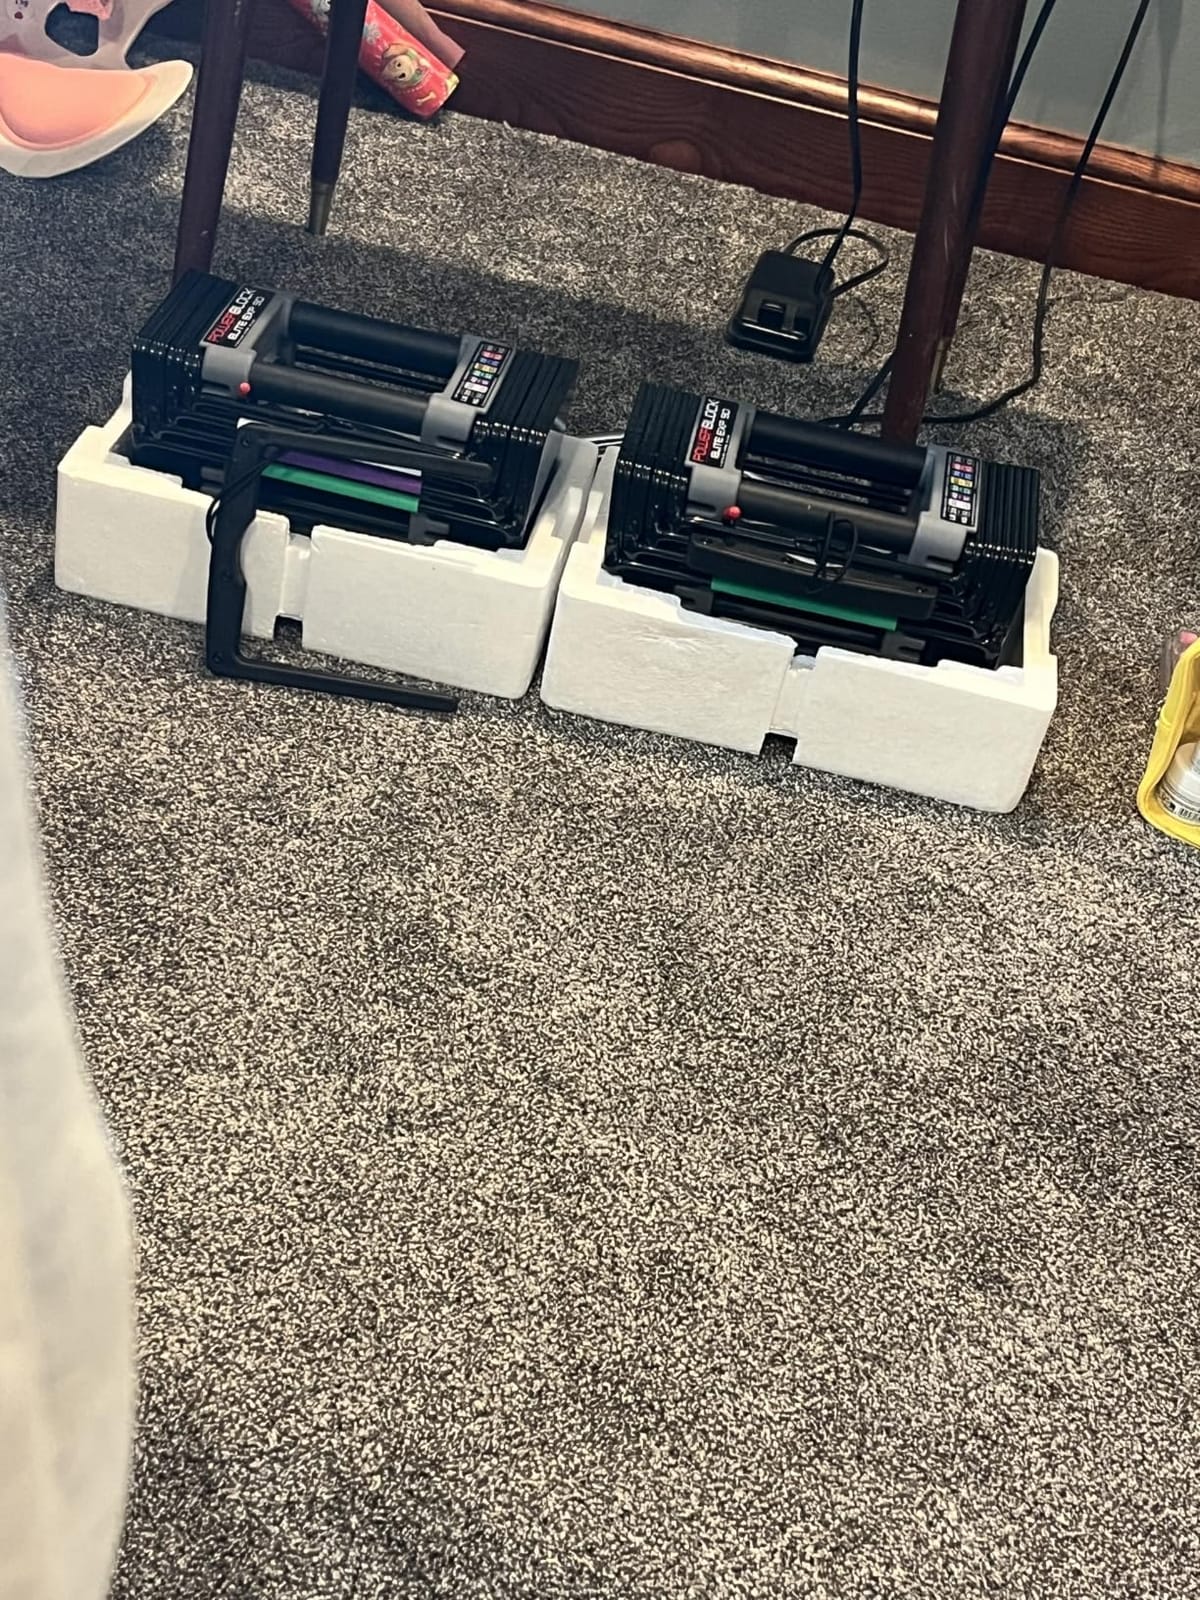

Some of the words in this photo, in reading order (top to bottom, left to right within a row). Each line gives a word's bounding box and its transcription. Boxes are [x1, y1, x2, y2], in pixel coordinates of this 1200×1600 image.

[227, 321, 248, 340] ELITE
[241, 306, 256, 321] EXP
[715, 420, 727, 436] EXP
[710, 436, 724, 459] ELITE
